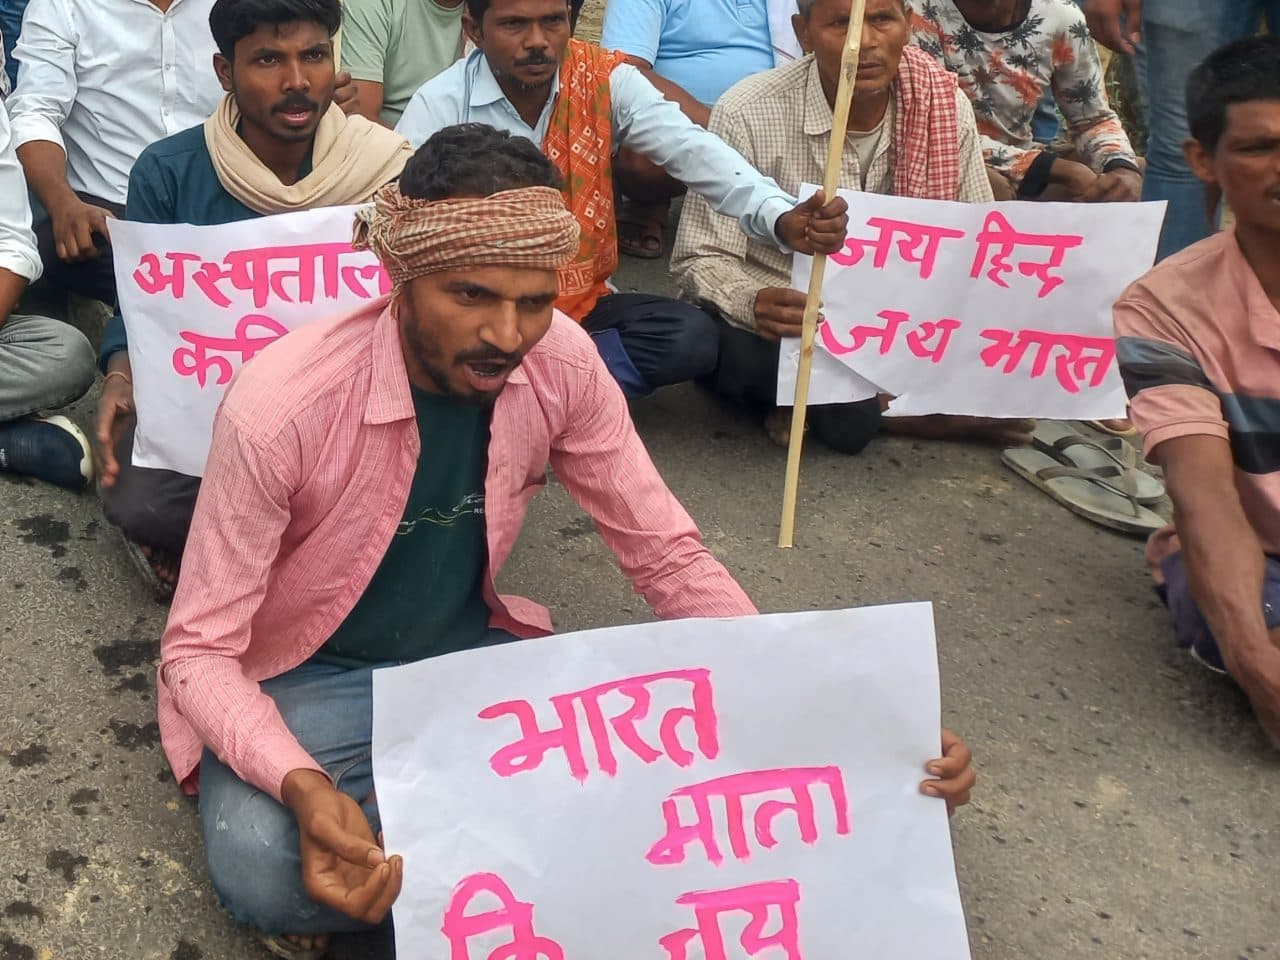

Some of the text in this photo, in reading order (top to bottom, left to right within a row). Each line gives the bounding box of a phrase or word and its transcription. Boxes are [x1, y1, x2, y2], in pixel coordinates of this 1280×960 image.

[827, 216, 966, 280] जय
[819, 309, 962, 365] जय
[477, 668, 720, 785] भारत
[645, 765, 852, 867] माता
